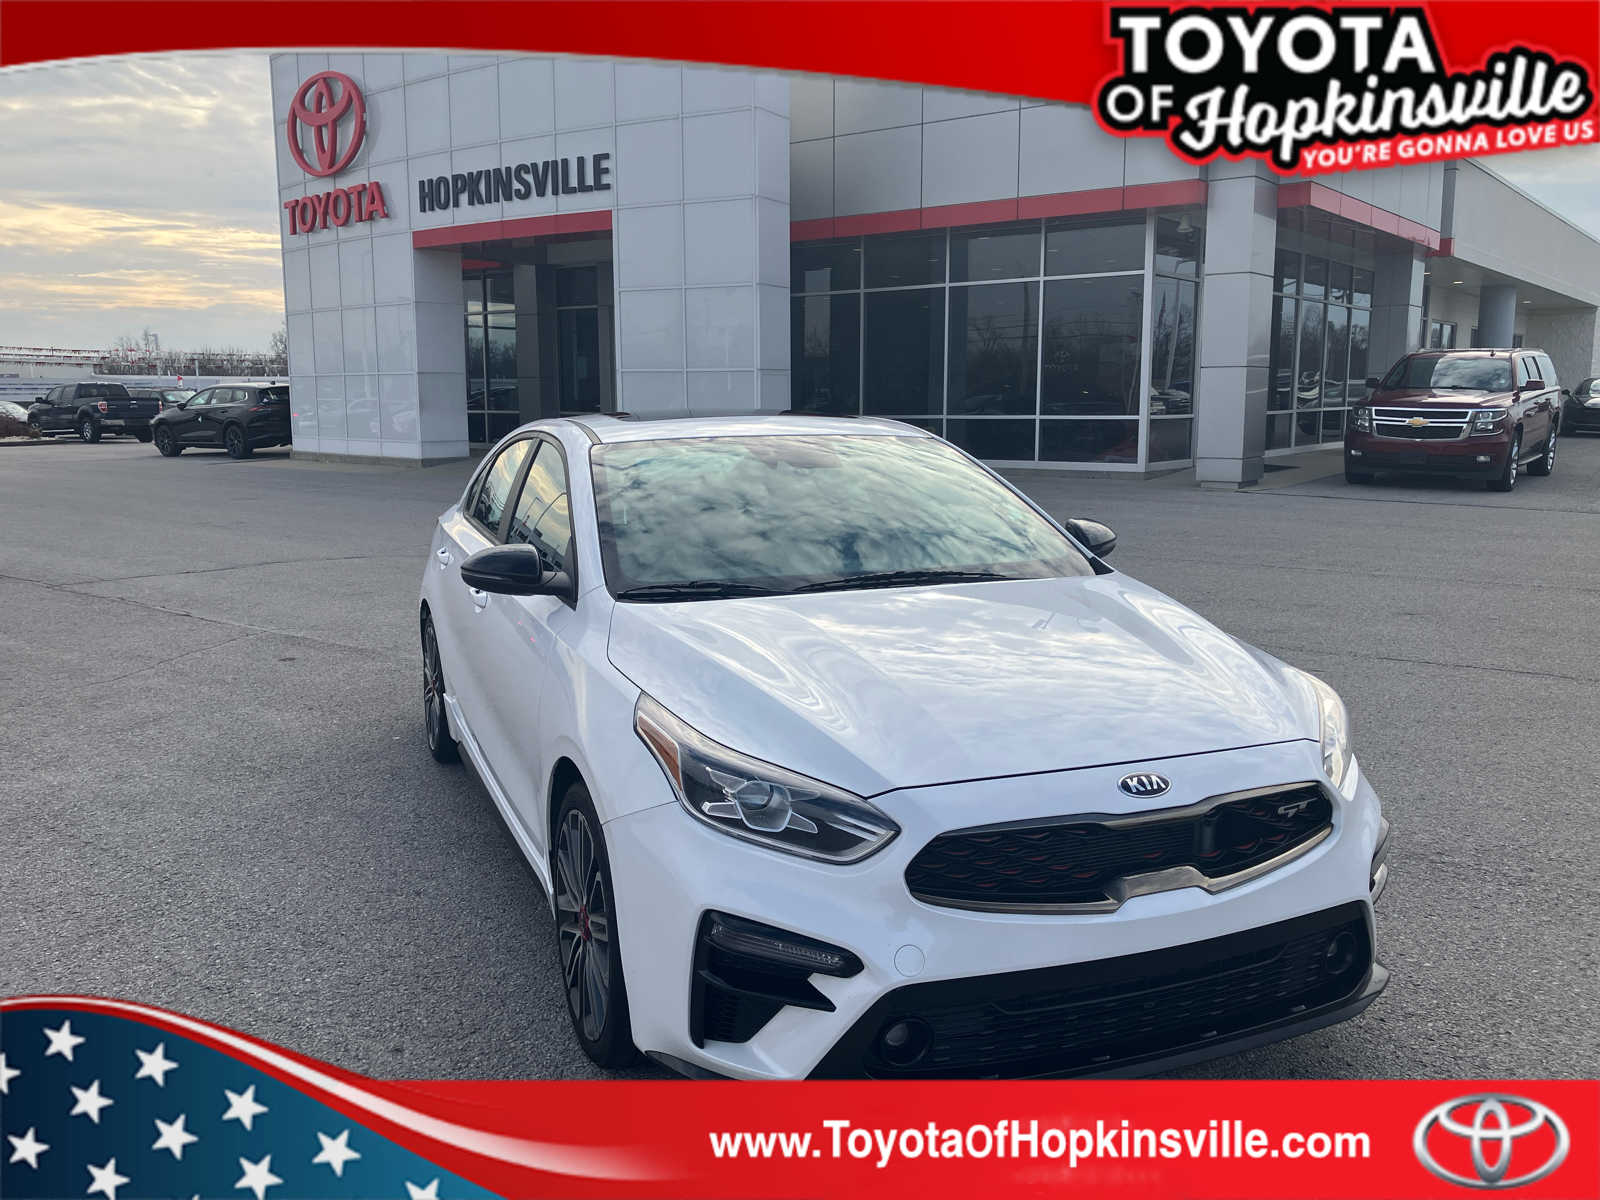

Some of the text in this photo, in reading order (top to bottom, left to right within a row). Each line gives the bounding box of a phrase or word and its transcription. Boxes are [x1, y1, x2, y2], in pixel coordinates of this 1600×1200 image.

[284, 181, 389, 235] TOYOTA
[419, 152, 611, 213] HOPKINSVILLE
[1126, 776, 1165, 793] KIA
